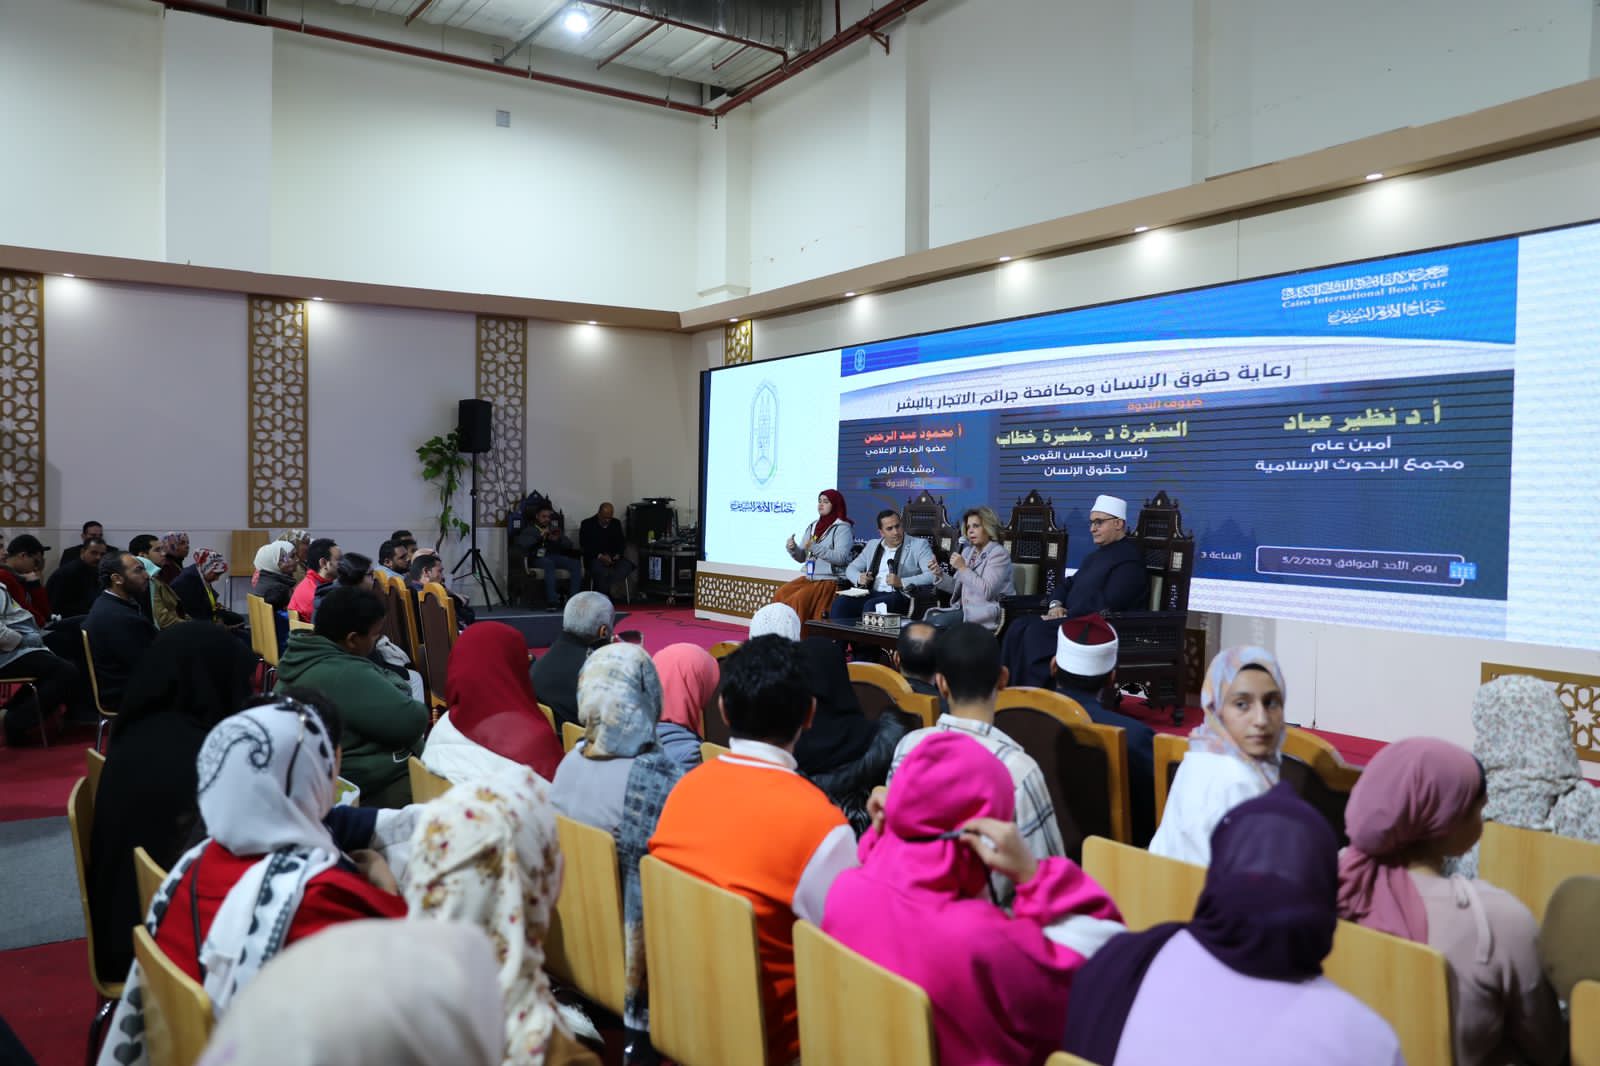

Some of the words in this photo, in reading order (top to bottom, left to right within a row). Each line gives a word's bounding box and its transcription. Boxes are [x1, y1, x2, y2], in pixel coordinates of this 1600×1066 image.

[1282, 298, 1310, 308] Cairo
[1314, 287, 1384, 304] International
[1388, 282, 1418, 295] Book
[1424, 280, 1448, 290] Fair
[1238, 362, 1291, 382] رعاية
[1100, 373, 1167, 392] الإنسان
[1174, 369, 1230, 388] حقوق
[980, 389, 1018, 405] جرائم
[1023, 383, 1095, 399] ومكافحة
[896, 396, 932, 412] بالبشر
[937, 392, 976, 408] الاتجار
[1128, 400, 1160, 412] الندوة
[1164, 398, 1203, 411] ضيوف
[1284, 412, 1332, 433] عياد
[1336, 406, 1396, 432] نظير
[864, 430, 897, 444] الرحمن
[900, 431, 917, 442] عبد
[920, 428, 954, 440] محمود
[1042, 426, 1093, 446] مشيرة
[1120, 420, 1188, 442] السفيرة
[996, 429, 1037, 447] خطاب
[1349, 435, 1392, 452] أمين
[865, 447, 896, 457] الإعلامي
[899, 445, 924, 454] المركز
[925, 444, 947, 453] عضو
[1114, 446, 1148, 458] رئيس
[1311, 440, 1344, 452] عام
[1021, 451, 1060, 463] القومي
[1064, 449, 1112, 461] المجلس
[876, 464, 898, 475] الأزهر
[898, 464, 936, 474] بمشيخة
[1086, 465, 1127, 476] لحقوق
[1255, 459, 1328, 474] الإسلامية
[1332, 458, 1398, 473] البحوث
[1403, 457, 1465, 472] مجمع
[1044, 465, 1083, 477] الإنسان
[886, 479, 908, 489] الندوة
[1200, 551, 1207, 559] 3
[1209, 551, 1242, 560] الساعة
[1282, 556, 1332, 566] 5/2/2023
[1335, 559, 1378, 570] الموافق
[1382, 560, 1409, 570] الأحد
[1412, 564, 1438, 574] يوم
